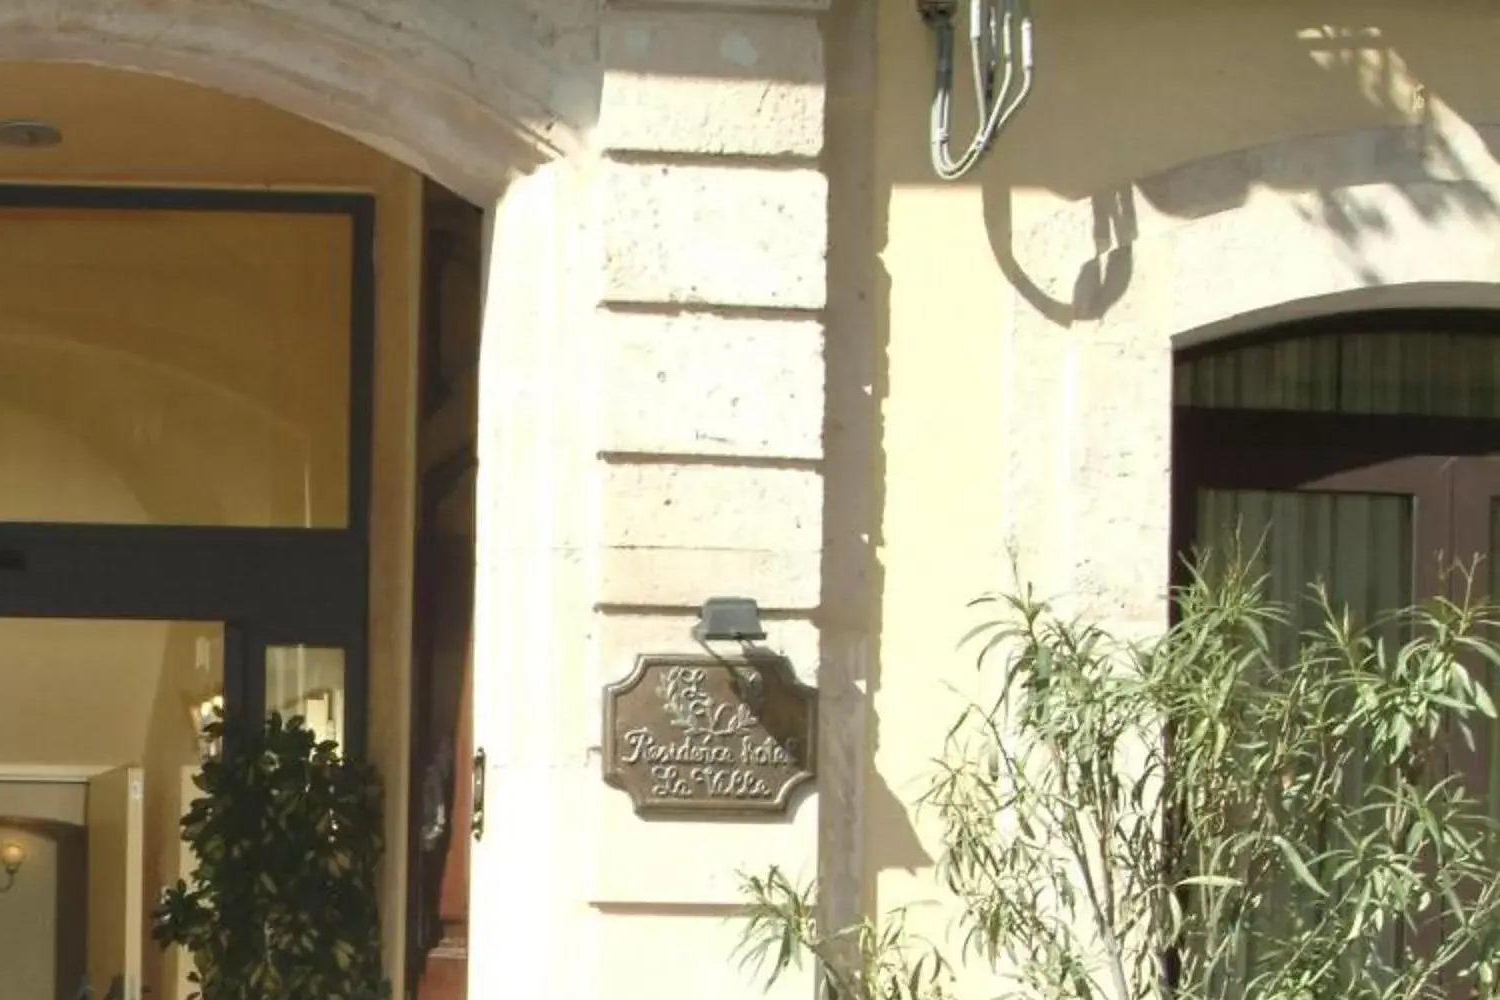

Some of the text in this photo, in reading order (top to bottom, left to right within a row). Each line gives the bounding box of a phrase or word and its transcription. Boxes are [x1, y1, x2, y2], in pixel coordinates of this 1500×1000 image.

[621, 726, 736, 764] Residence
[650, 765, 773, 797] La Ville
